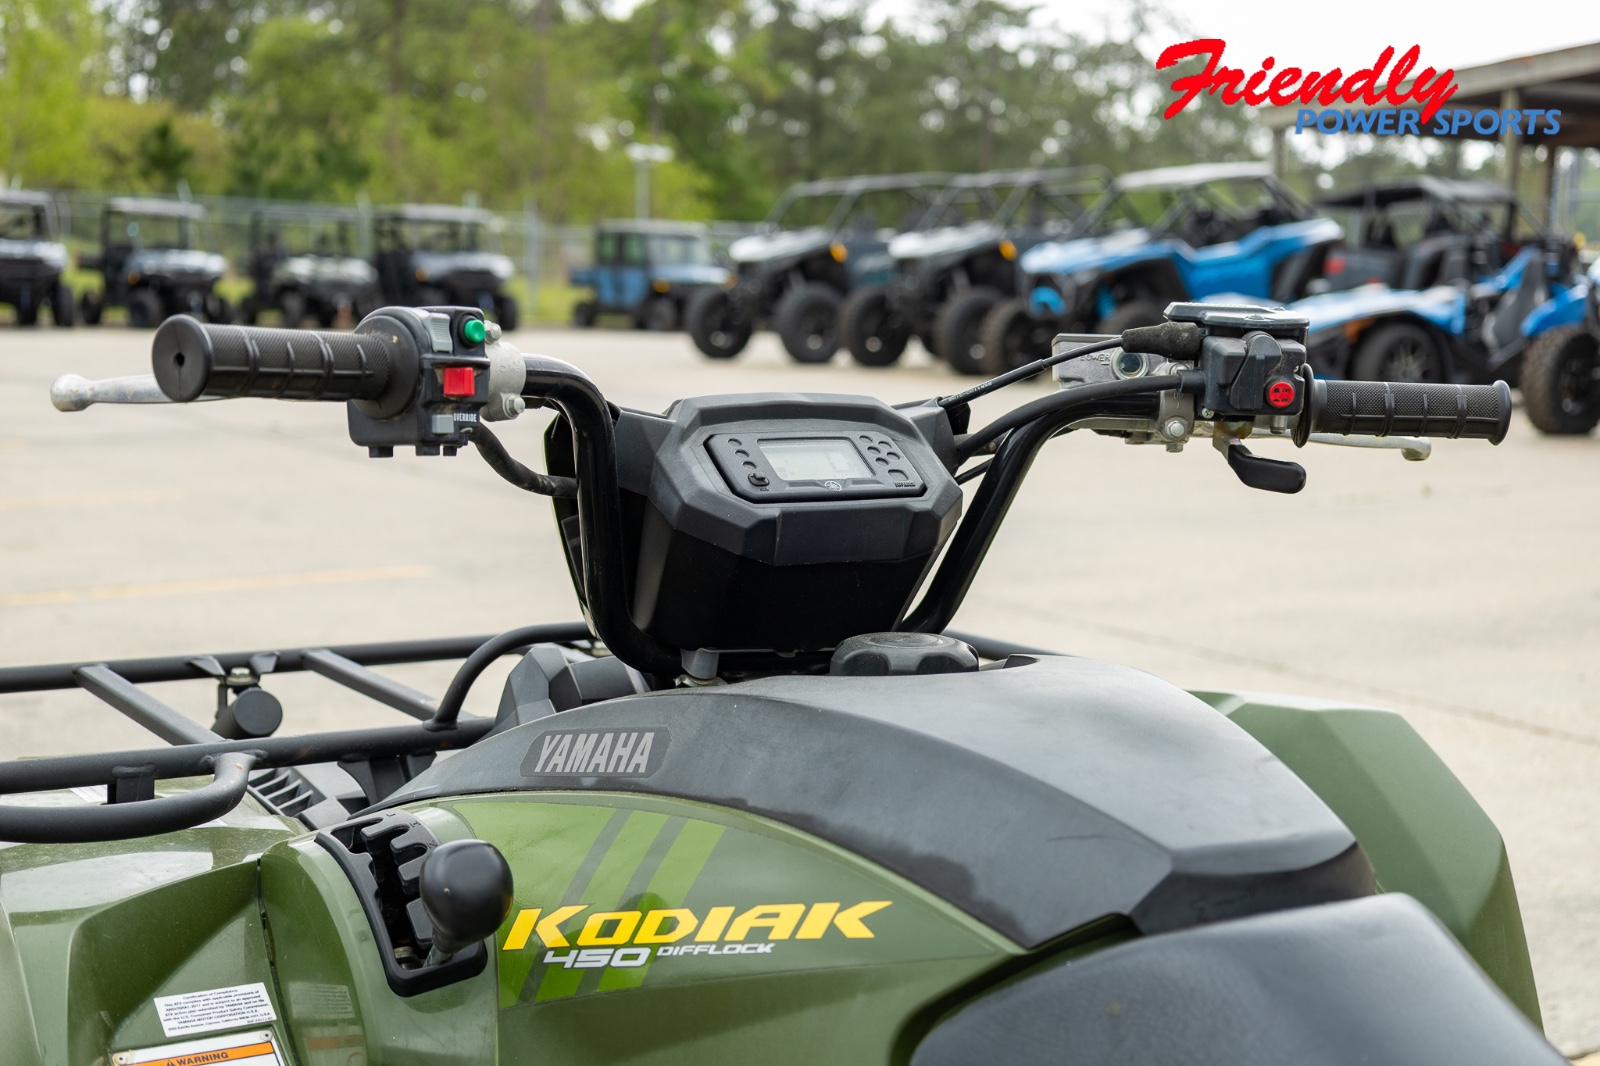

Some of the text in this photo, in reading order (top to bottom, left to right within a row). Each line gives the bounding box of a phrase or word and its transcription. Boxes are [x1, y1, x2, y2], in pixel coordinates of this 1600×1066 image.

[454, 412, 476, 422] OVERRIDE
[533, 732, 655, 773] YAMAHA
[502, 901, 893, 951] KODIAK
[543, 942, 776, 969] 450 DIFFLOCK
[176, 1052, 229, 1066] WARNING
